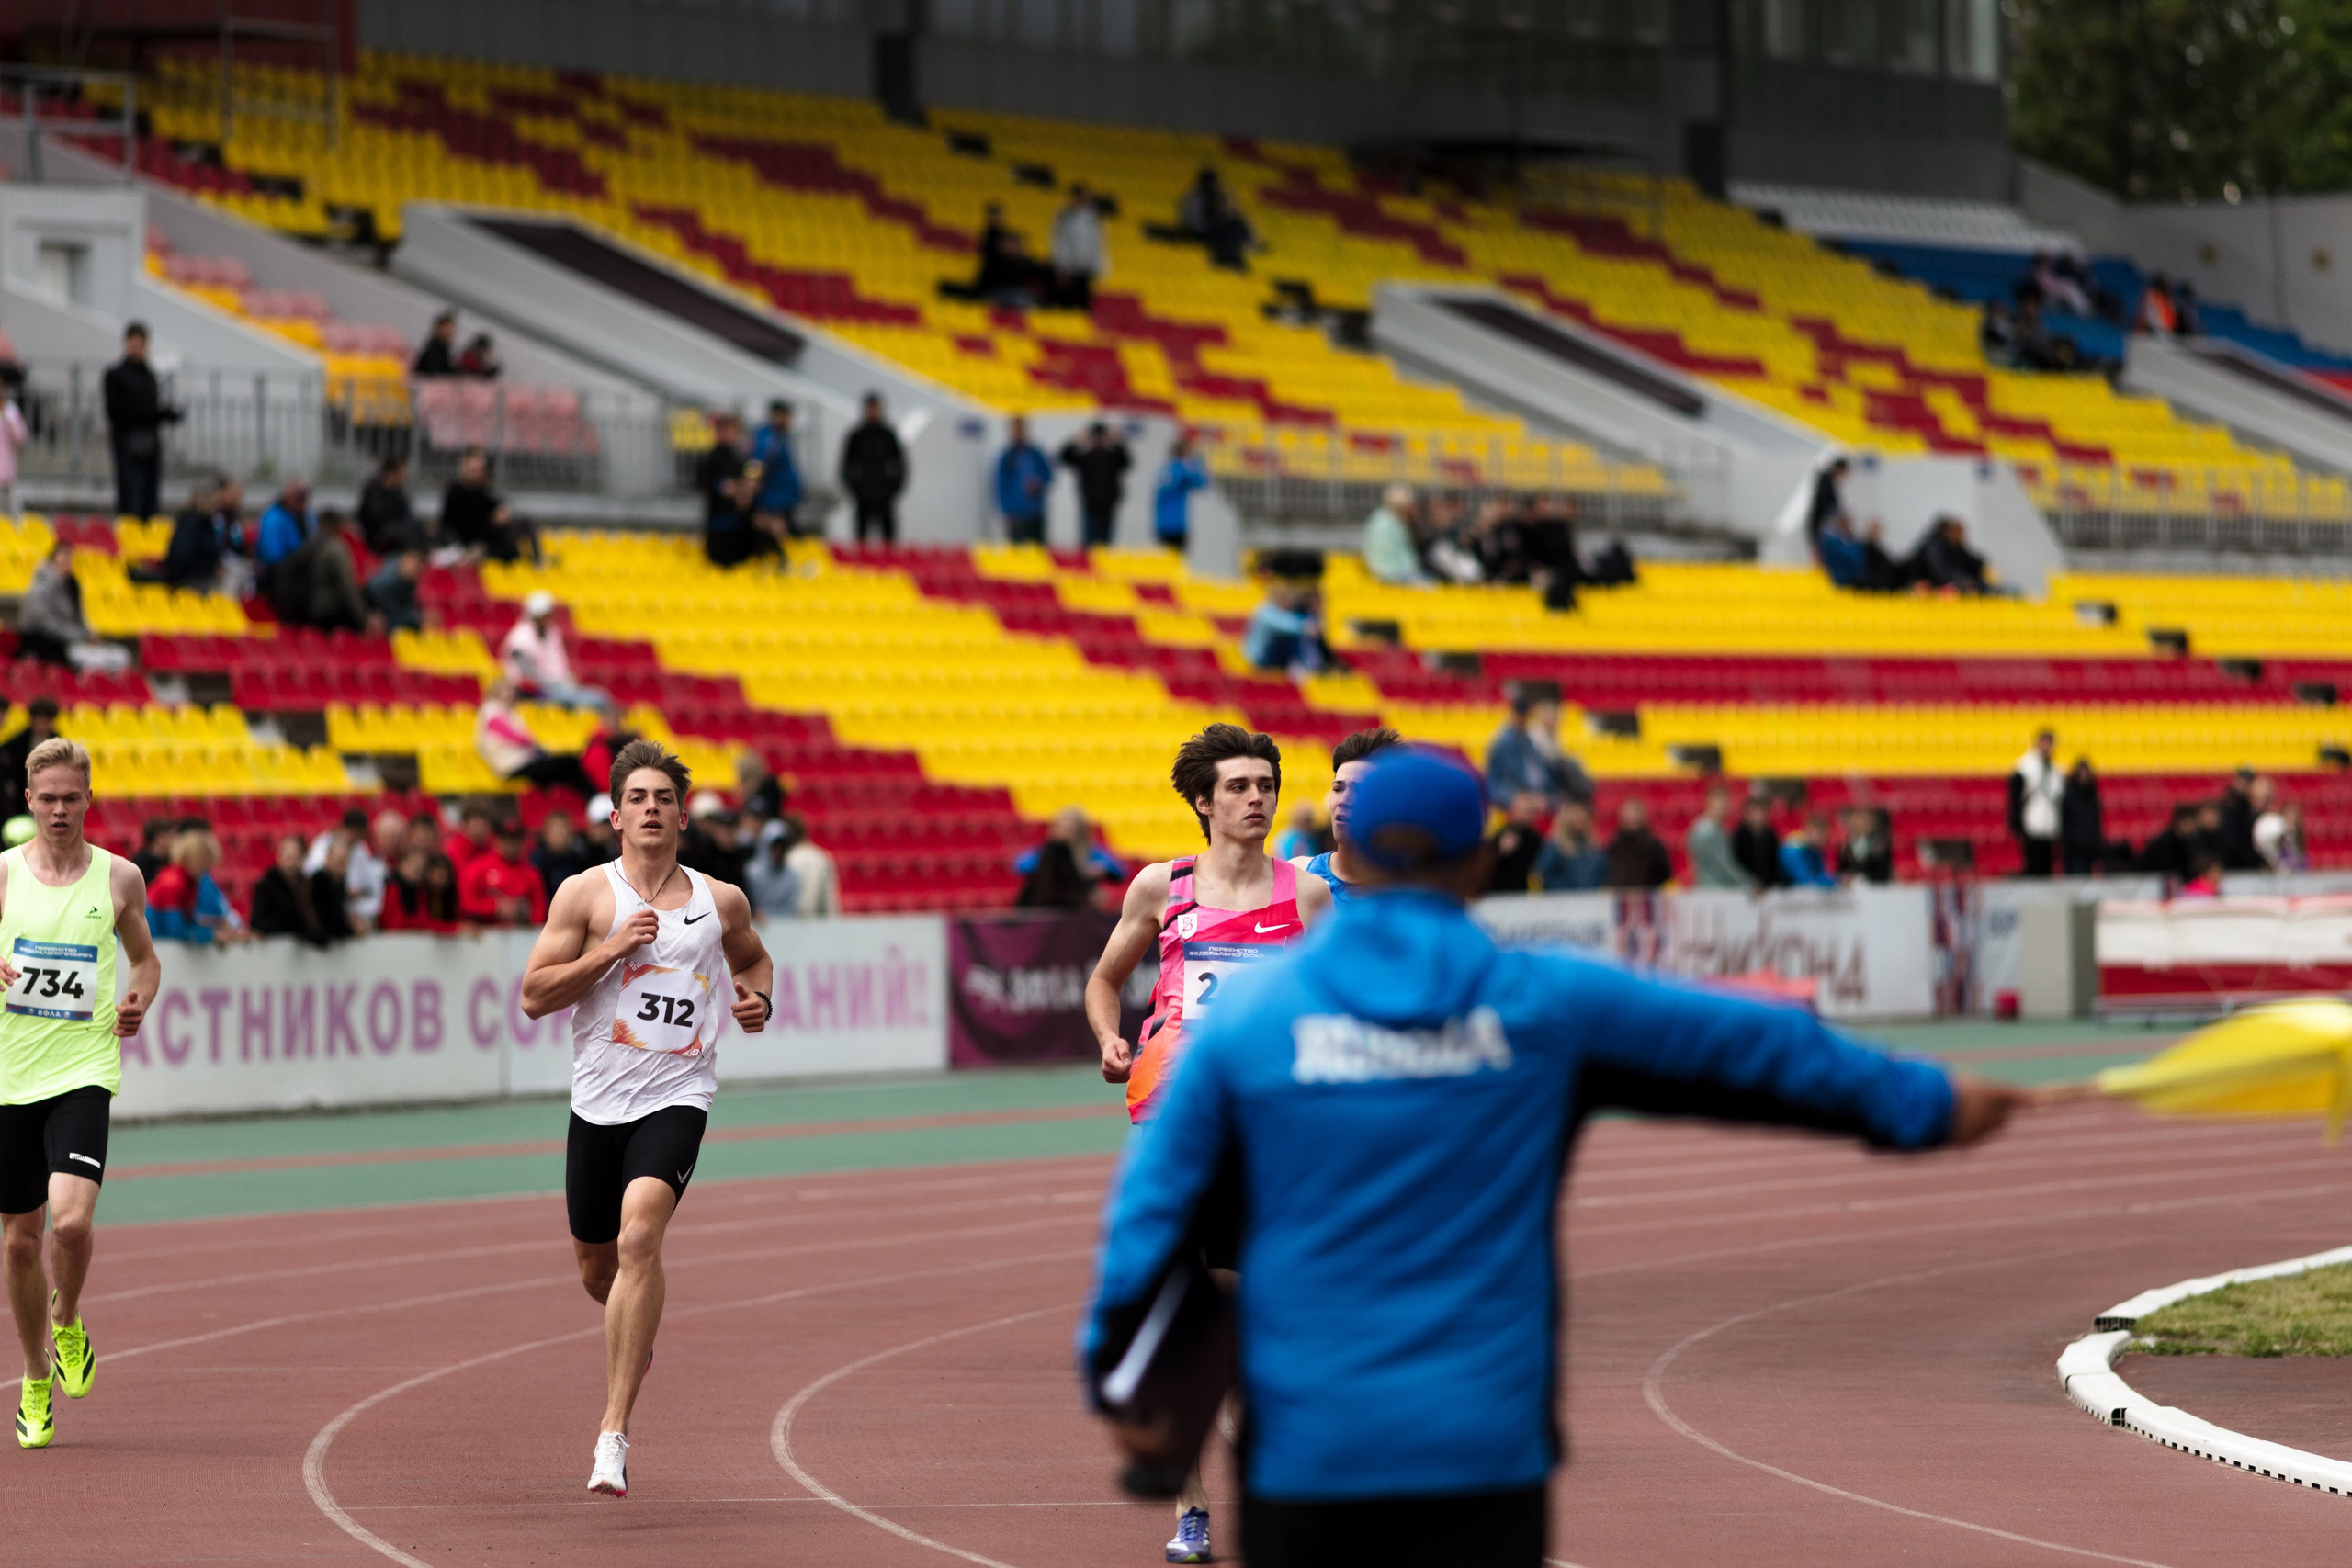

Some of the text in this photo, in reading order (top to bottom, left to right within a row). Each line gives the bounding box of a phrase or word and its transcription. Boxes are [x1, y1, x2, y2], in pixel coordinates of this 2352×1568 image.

[22, 966, 84, 999] 734
[1196, 972, 1218, 1005] 2
[119, 976, 446, 1069] АСТНИКОВ
[636, 992, 695, 1028] 312
